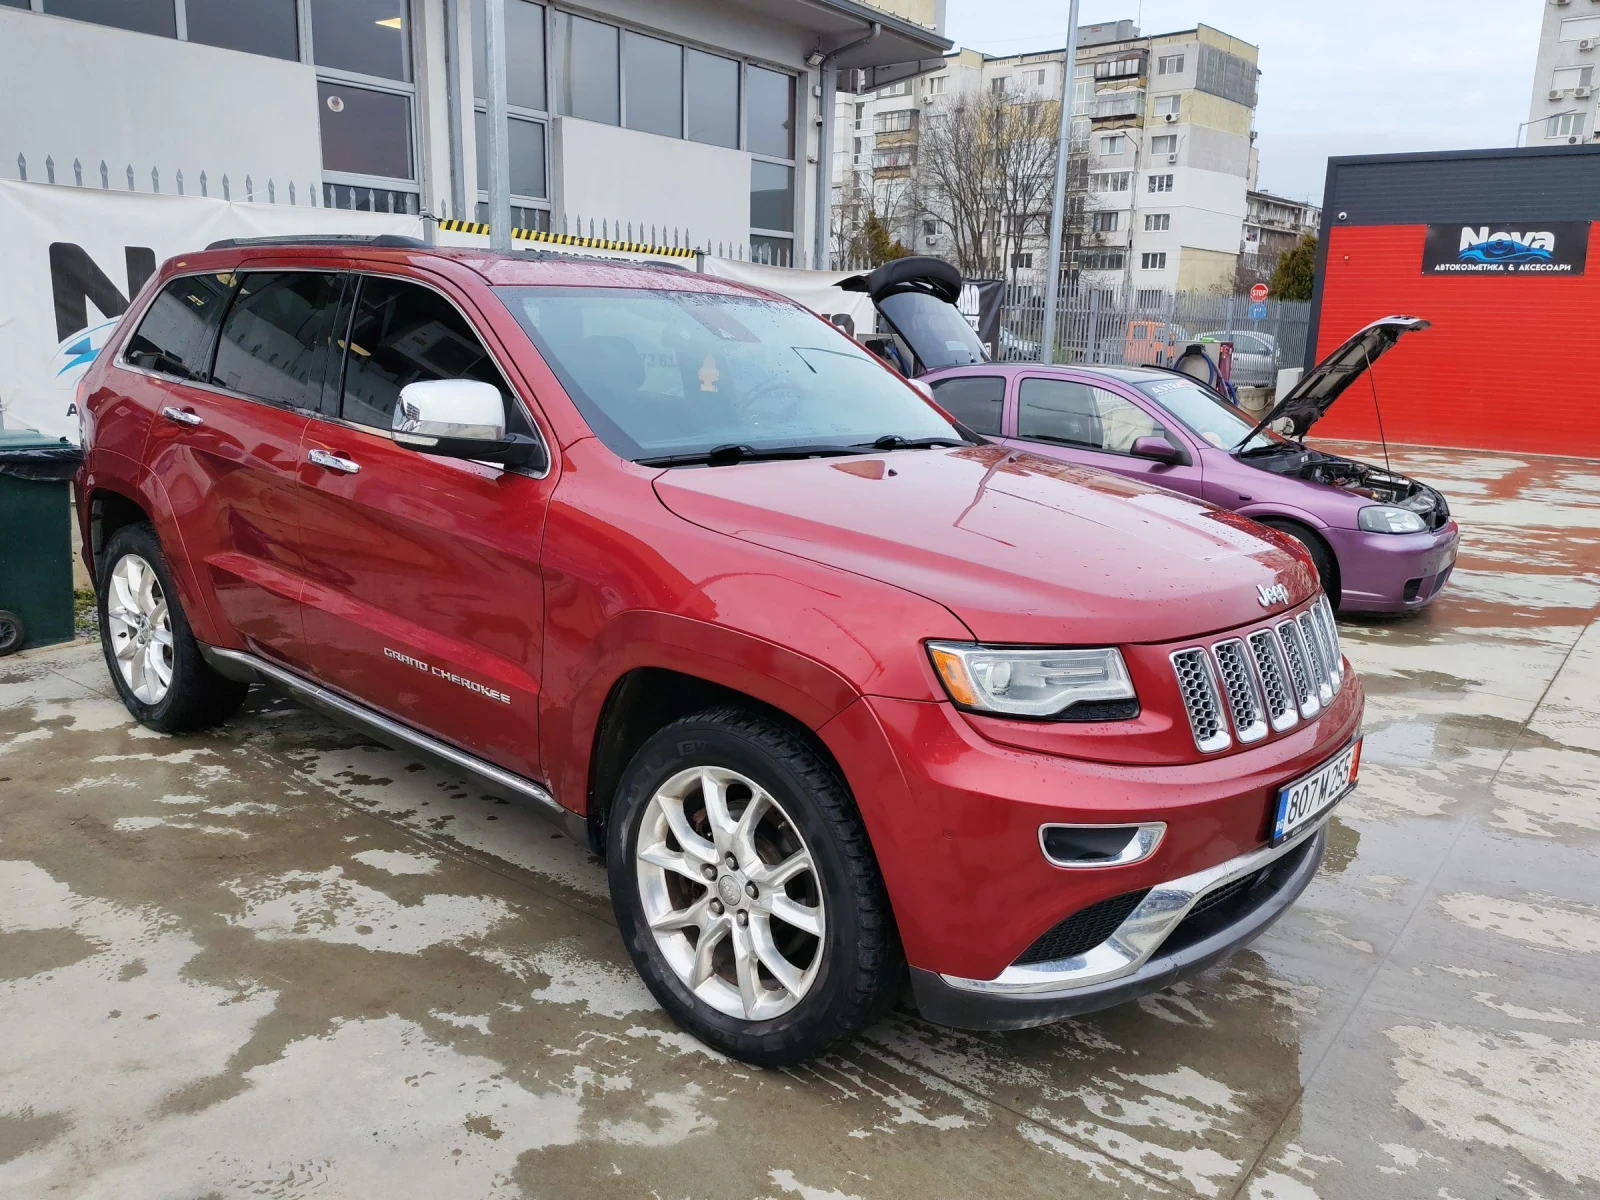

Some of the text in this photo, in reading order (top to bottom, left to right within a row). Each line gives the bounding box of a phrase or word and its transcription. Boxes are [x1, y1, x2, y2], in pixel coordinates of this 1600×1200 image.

[1459, 226, 1555, 252] Nova
[1434, 263, 1572, 272] АВТОКОЗМЕТИКА & АКСЕСОАРИ
[1252, 289, 1266, 297] STOP
[1256, 583, 1289, 607] Jeep
[383, 647, 511, 704] GRAND CHEROKEE
